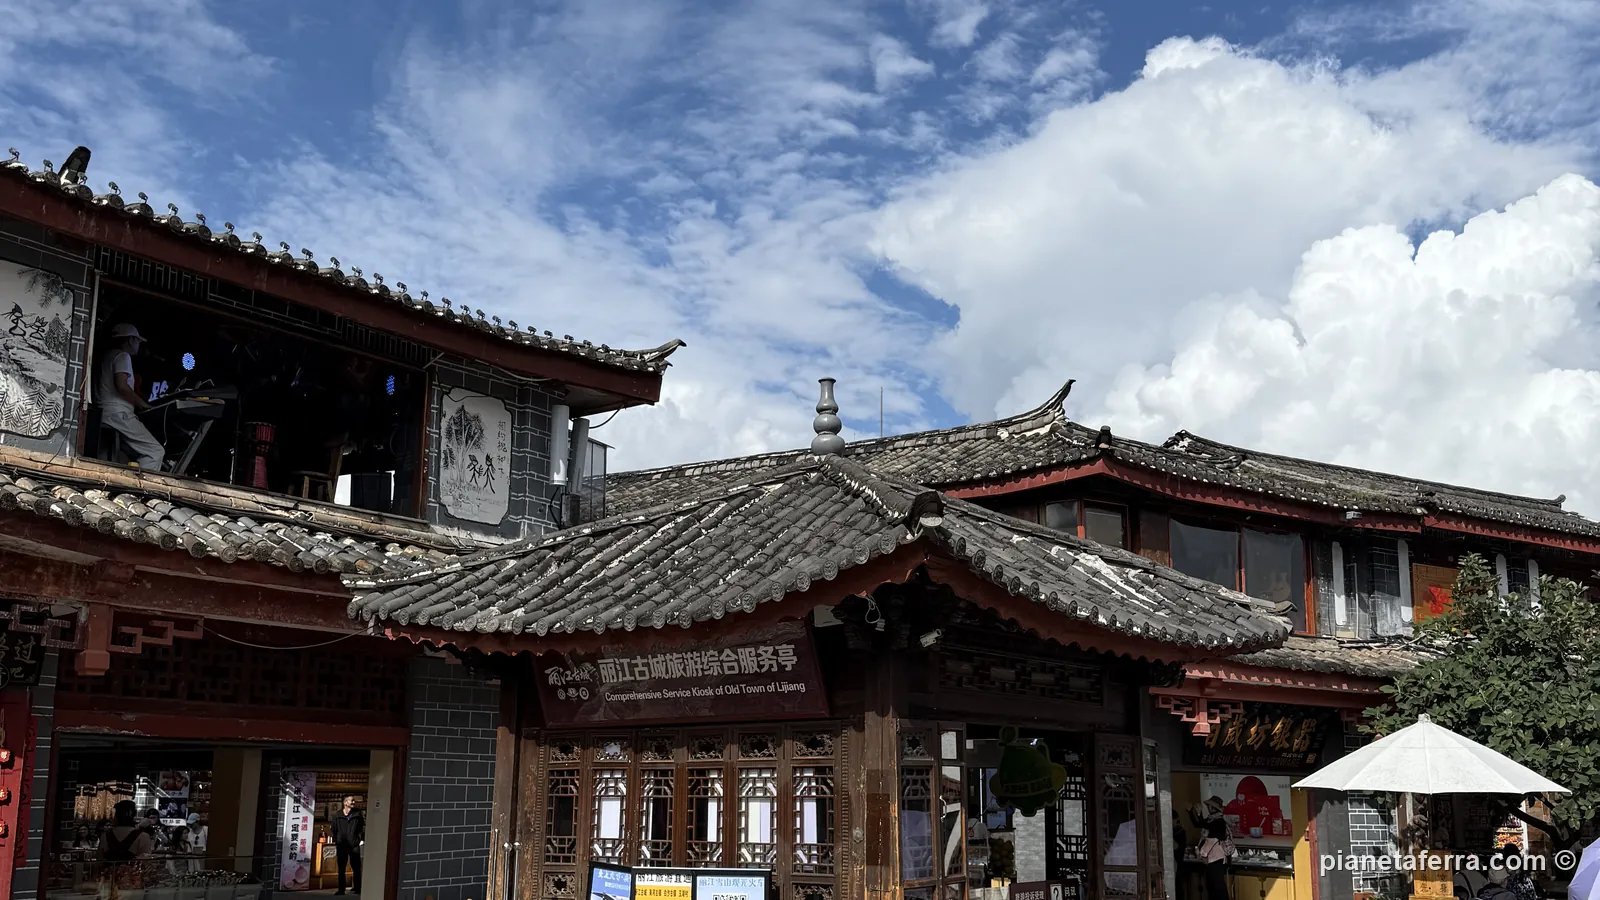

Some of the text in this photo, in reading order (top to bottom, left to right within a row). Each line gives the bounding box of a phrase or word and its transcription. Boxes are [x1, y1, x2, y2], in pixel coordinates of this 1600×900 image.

[597, 644, 798, 683] 丽江古城旅游综合服务亭
[605, 681, 806, 702] Comprehensive Service Kiosk of Old Town of Lijiang
[1200, 754, 1215, 764] BAI
[1216, 755, 1231, 764] SUI
[1232, 755, 1254, 766] FANG
